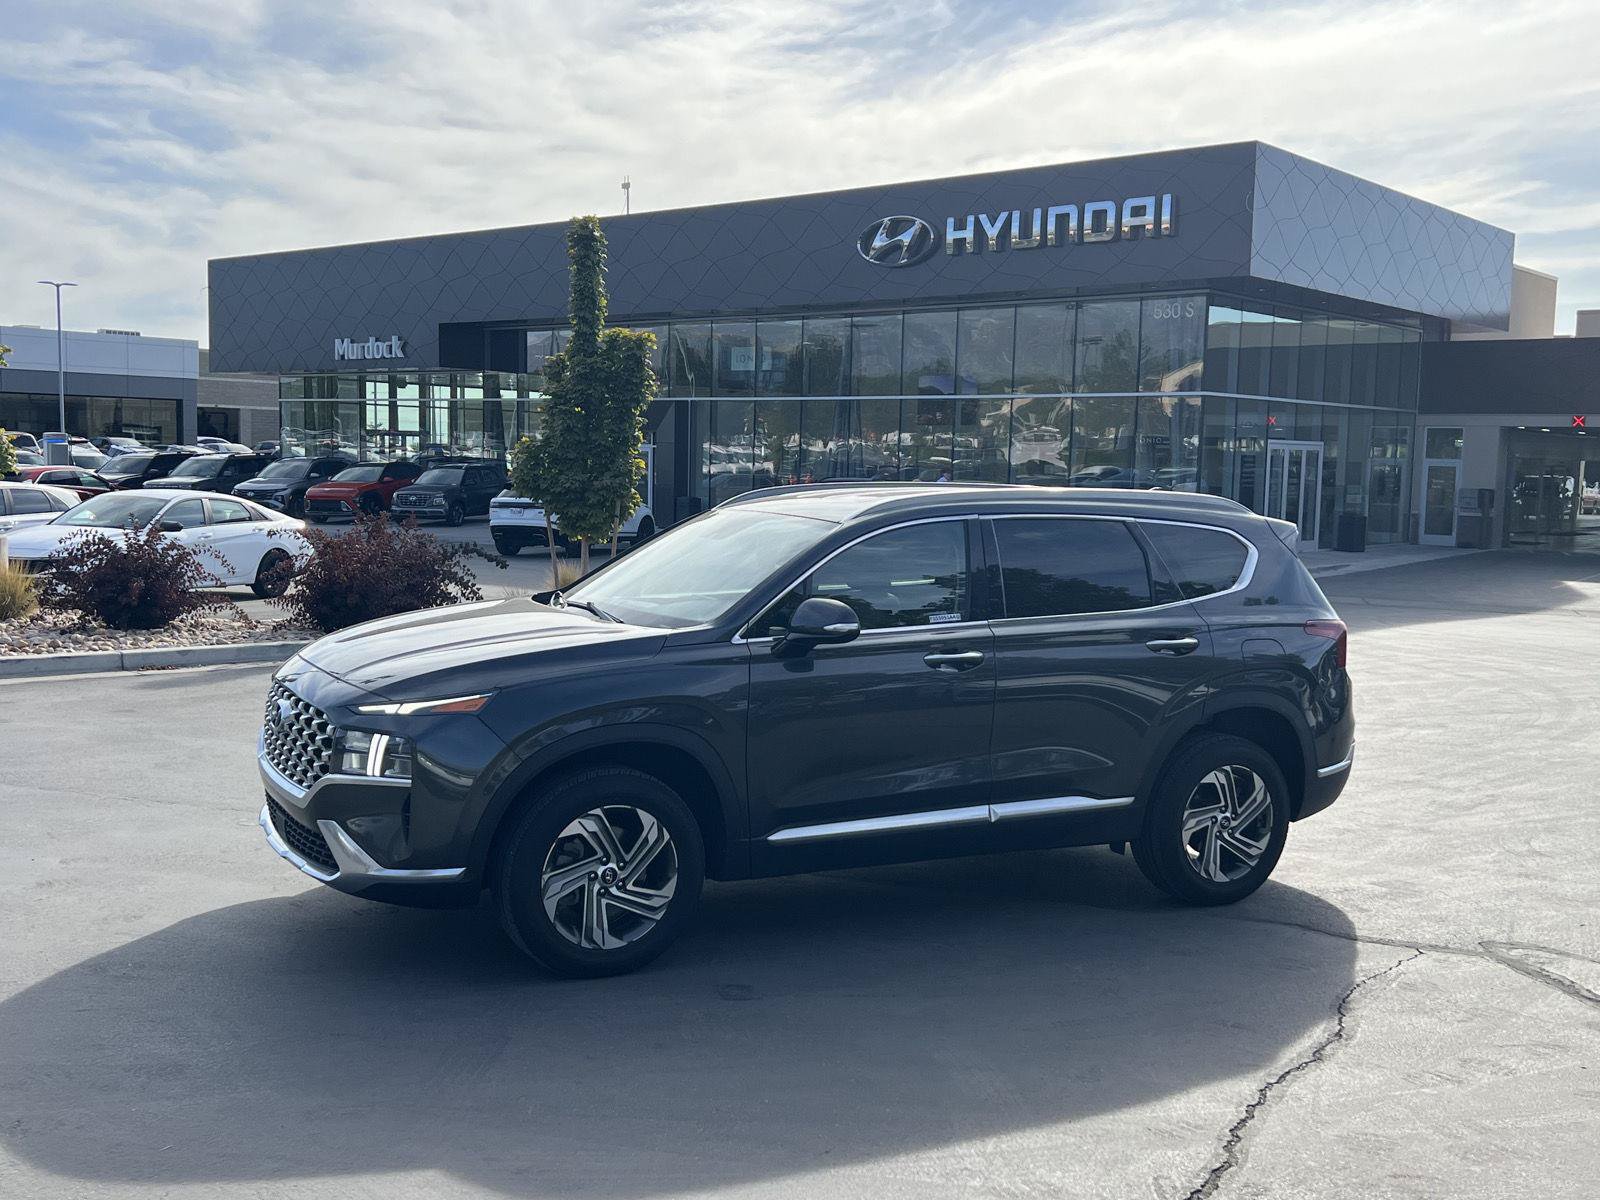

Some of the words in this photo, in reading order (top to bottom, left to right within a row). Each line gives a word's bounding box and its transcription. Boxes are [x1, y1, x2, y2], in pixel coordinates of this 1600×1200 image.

[945, 193, 1173, 255] HYUNDAI
[1185, 302, 1194, 317] S
[334, 335, 405, 360] Murdock
